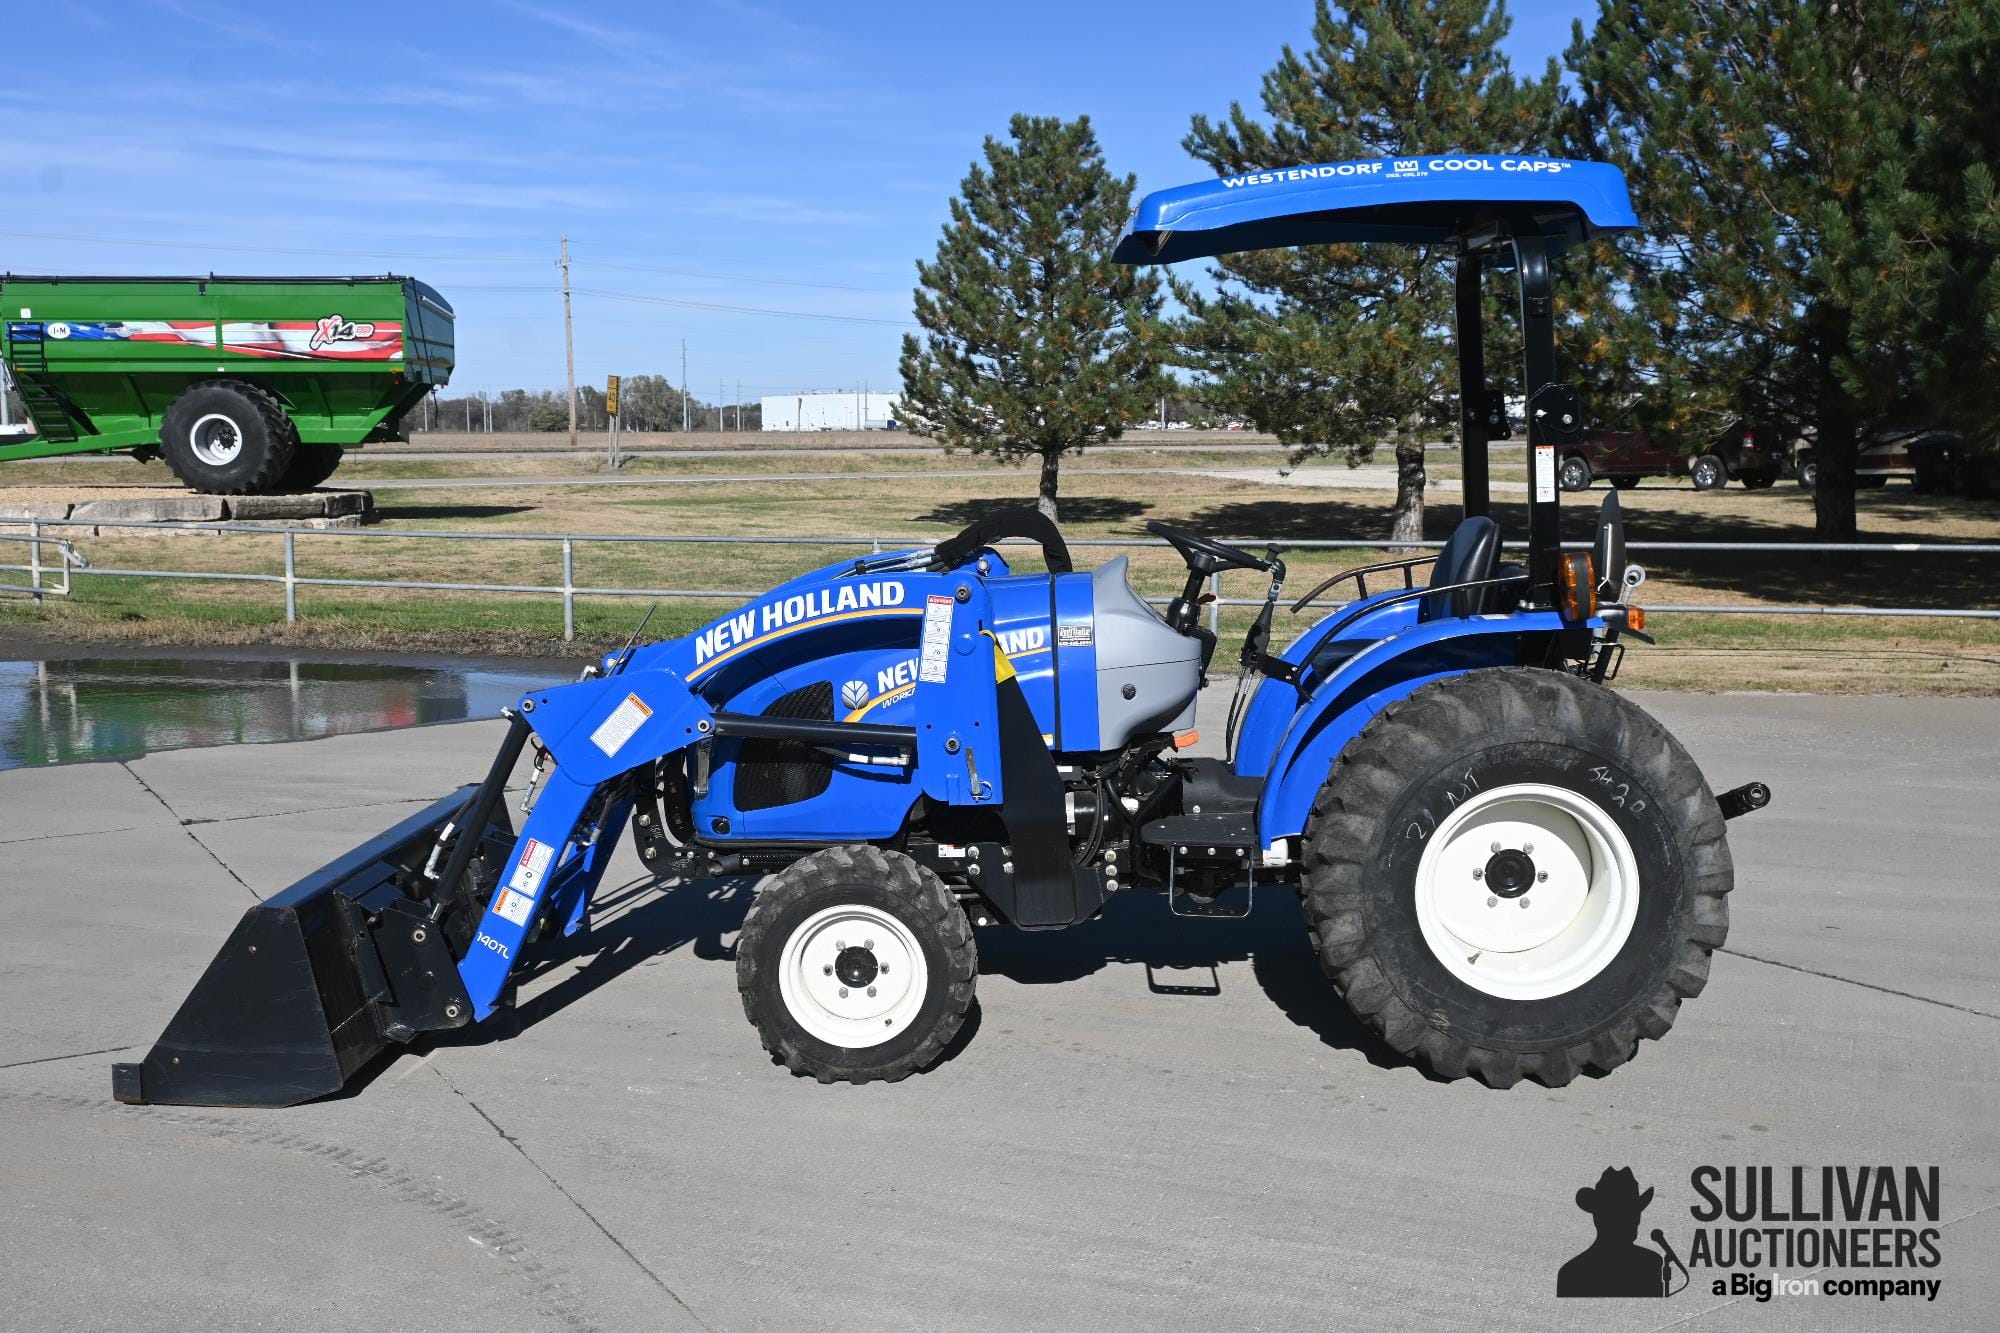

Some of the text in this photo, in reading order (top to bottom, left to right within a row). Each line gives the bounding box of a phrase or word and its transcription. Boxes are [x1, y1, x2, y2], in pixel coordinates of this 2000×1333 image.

[1222, 162, 1383, 188] WESTENDORF
[1429, 159, 1495, 172] COOL
[695, 581, 905, 666] NEW HOLLAND
